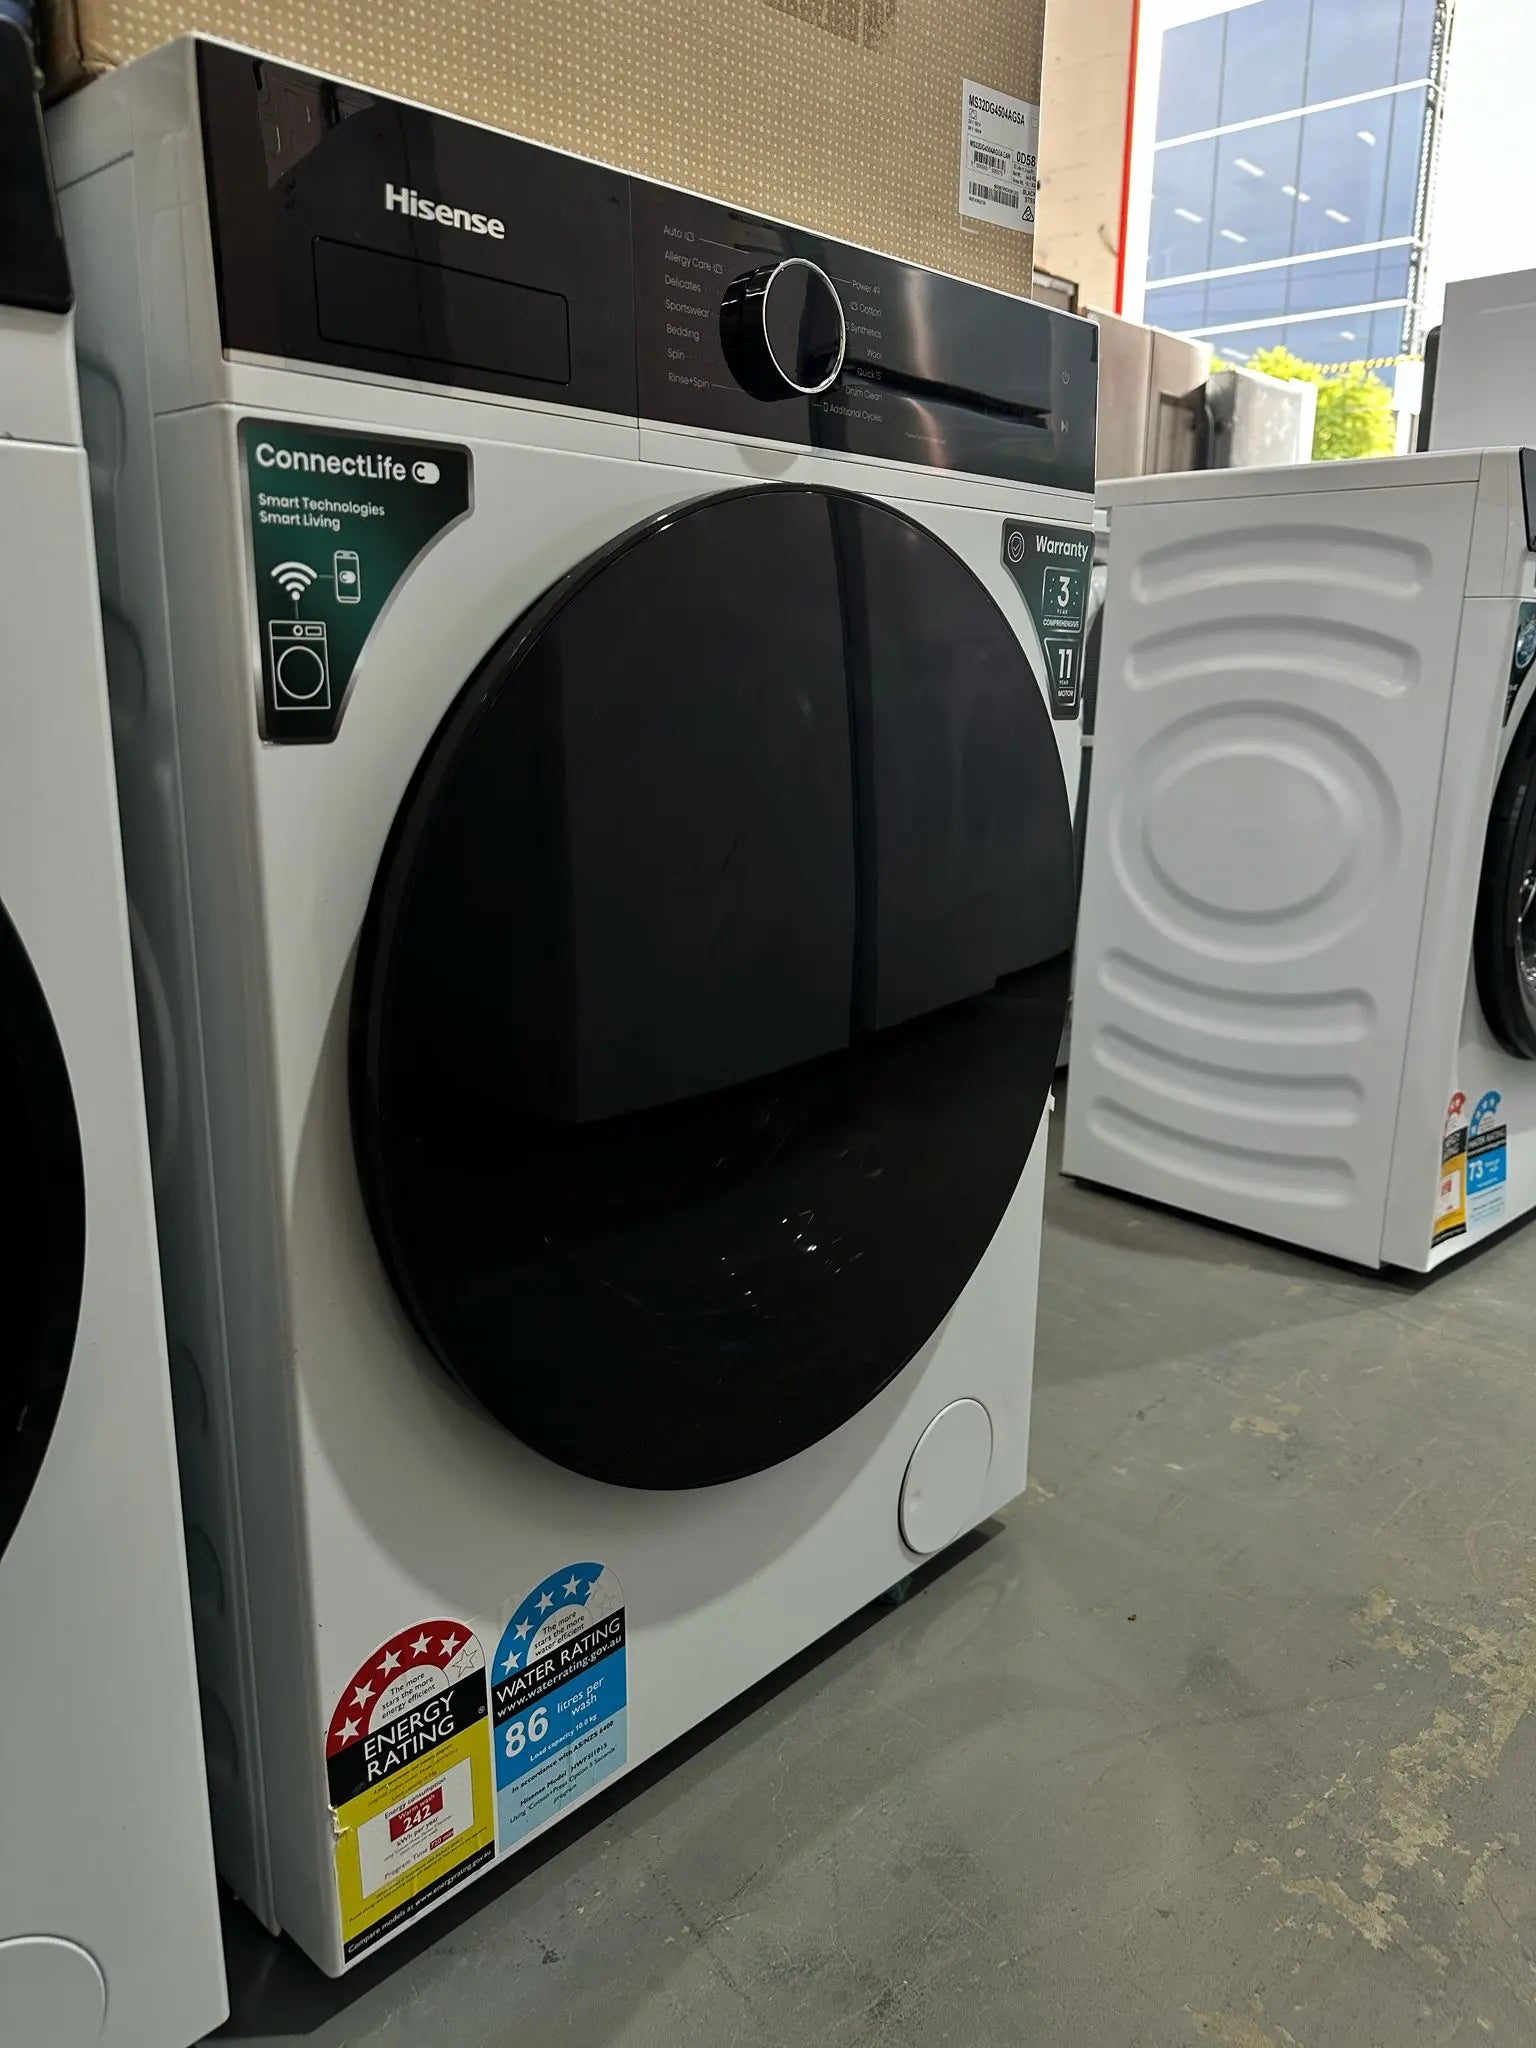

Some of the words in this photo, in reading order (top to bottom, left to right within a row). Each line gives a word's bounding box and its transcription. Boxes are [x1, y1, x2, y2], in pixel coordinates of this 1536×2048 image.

[968, 93, 1025, 126] MS32DG4504AGSA
[1016, 151, 1036, 167] 0D58
[385, 182, 505, 239] Hisense
[663, 225, 682, 238] Auto
[664, 251, 691, 268] Allergy
[692, 258, 711, 271] Care
[665, 274, 701, 292] Delicates
[852, 279, 871, 294] Power
[665, 299, 709, 318] Sportswear
[860, 303, 882, 317] Cotton
[666, 324, 699, 342] Bedding
[851, 322, 882, 339] Synthetics
[667, 347, 685, 361] Spin
[867, 348, 882, 360] Wool
[668, 372, 710, 389] Rinse+Spin
[857, 367, 874, 379] Quick
[845, 386, 863, 399] Drum
[864, 390, 882, 401] Clean
[829, 403, 861, 419] Additional
[862, 410, 882, 423] Cycles
[255, 442, 406, 481] ConnectLife
[258, 492, 299, 509] Smart
[302, 497, 385, 517] Technologies
[259, 510, 300, 526] Smart
[303, 515, 341, 532] Living
[1036, 535, 1089, 562] Warranty
[1057, 575, 1071, 608] 3
[1043, 618, 1080, 628] COMPREHENSIVE
[1058, 648, 1073, 679] 11
[1057, 689, 1074, 697] MOTOR
[534, 1635, 552, 1650] stars
[553, 1628, 565, 1638] the
[566, 1615, 585, 1631] more
[543, 1625, 557, 1636] The
[558, 1611, 577, 1626] more
[535, 1640, 556, 1657] water
[556, 1623, 585, 1644] efficient
[496, 1659, 556, 1703] WATER
[561, 1617, 620, 1666] RATING
[391, 1685, 404, 1696] The
[406, 1673, 425, 1687] more
[497, 1635, 622, 1718] www.waterrating.gov.au
[382, 1697, 400, 1710] stars
[401, 1688, 414, 1699] the
[415, 1677, 434, 1691] more
[382, 1702, 406, 1719] energy
[408, 1685, 436, 1703] efficient
[557, 1690, 584, 1714] litres
[586, 1677, 605, 1698] per
[571, 1694, 597, 1716] wash
[364, 1690, 455, 1761] ENERGY
[505, 1706, 549, 1758] 86
[367, 1714, 455, 1782] RATING
[530, 1748, 547, 1762] Load
[547, 1729, 575, 1750] capacity
[512, 1785, 519, 1794] In
[520, 1760, 557, 1788] accordance
[558, 1750, 573, 1762] with
[385, 1803, 407, 1819] Energy
[407, 1777, 447, 1804] consumption
[520, 1786, 546, 1807] Hisense
[547, 1770, 567, 1788] Model
[553, 1784, 577, 1804] program
[398, 1805, 419, 1820] Warm
[420, 1794, 436, 1807] wash
[403, 1804, 432, 1832] 242
[509, 1810, 527, 1824] Using
[397, 1834, 413, 1847] kWh
[414, 1826, 424, 1837] per
[425, 1816, 440, 1829] year
[384, 1859, 412, 1880] Program
[413, 1847, 428, 1859] Time
[348, 1927, 381, 1953] Compare
[381, 1910, 406, 1931] models
[407, 1903, 415, 1914] at
[415, 1850, 493, 1907] www.energyrating.gov.au
